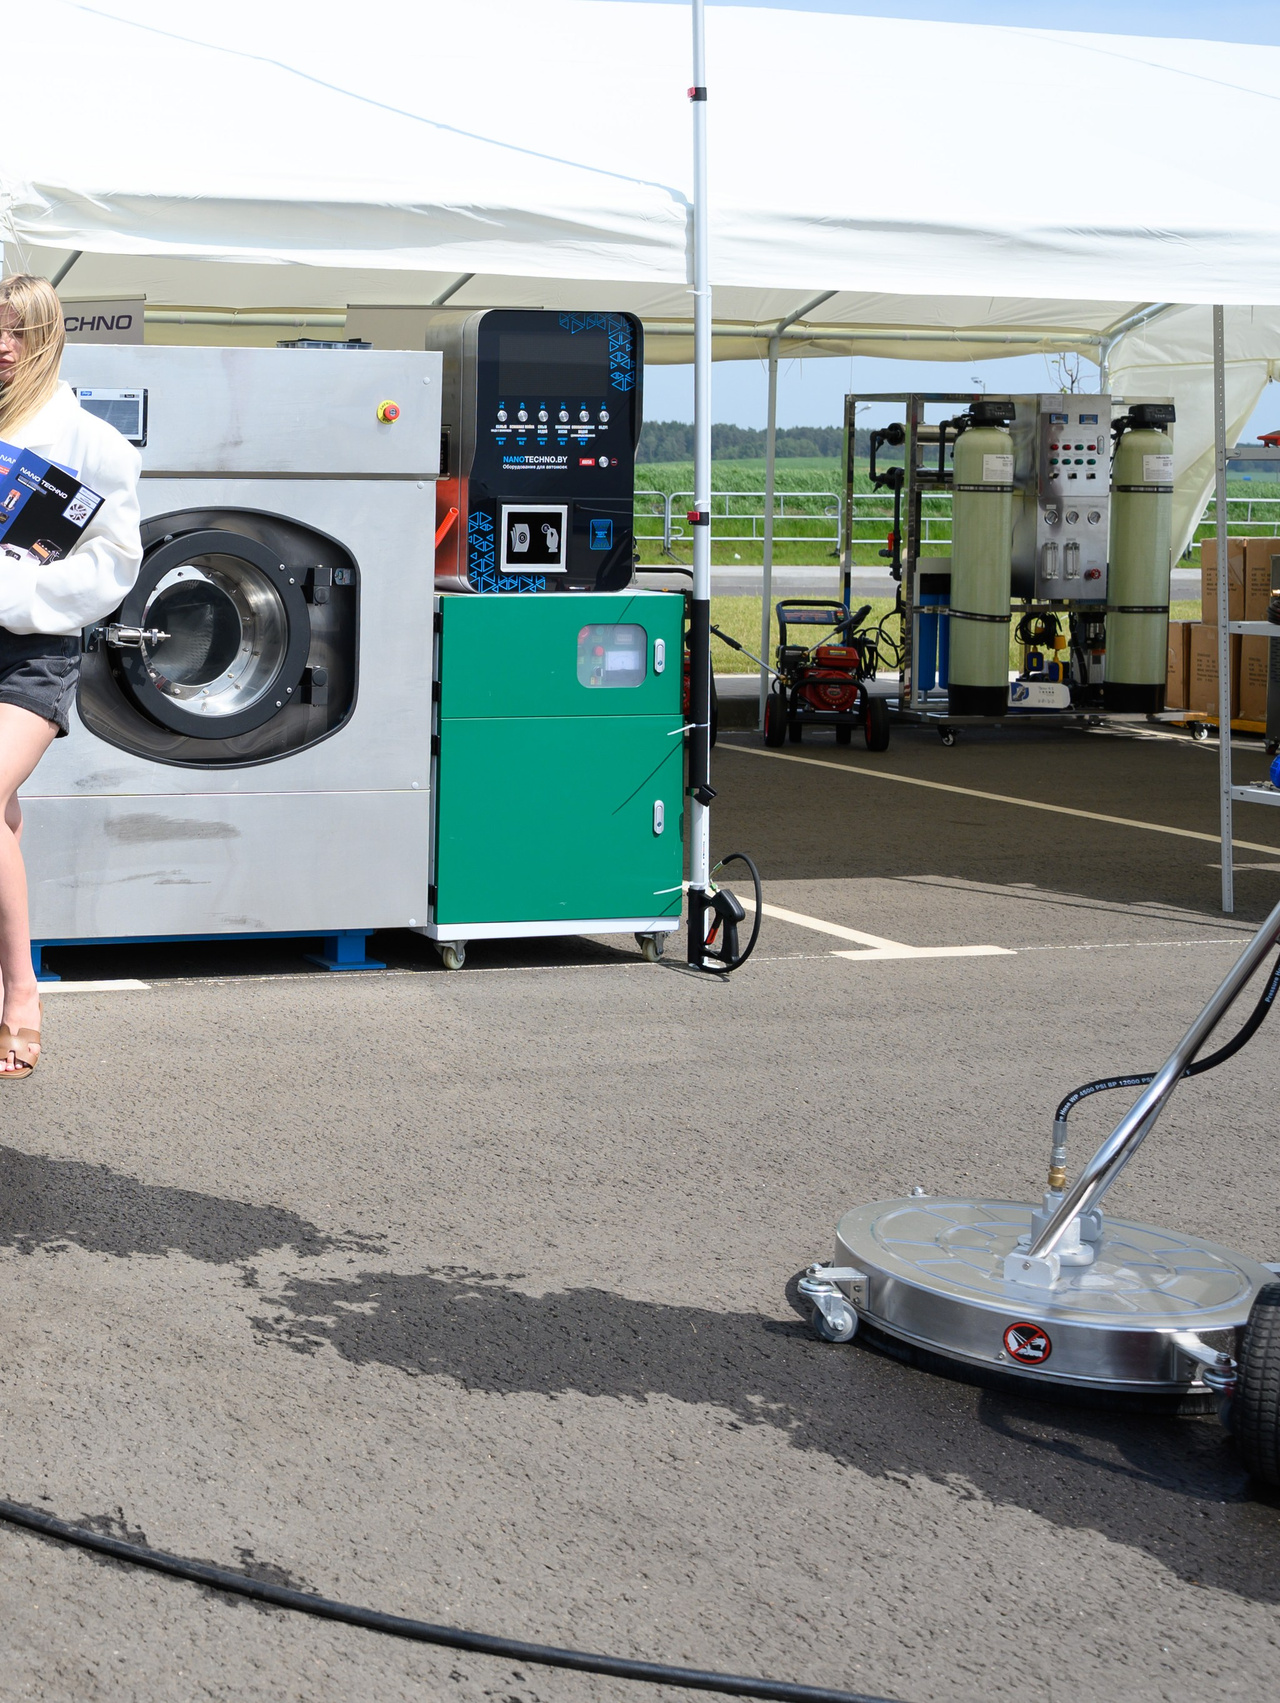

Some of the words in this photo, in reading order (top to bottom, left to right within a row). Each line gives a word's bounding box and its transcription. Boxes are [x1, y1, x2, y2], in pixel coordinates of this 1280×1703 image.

[64, 314, 133, 332] CHNO
[0, 454, 17, 464] NAN
[503, 455, 568, 464] NANOTECHNO.BY
[19, 466, 41, 482] NANO
[41, 479, 68, 500] TECHNO
[1068, 1093, 1079, 1103] WP
[1079, 1086, 1095, 1097] 4500
[1095, 1082, 1108, 1091] PSI
